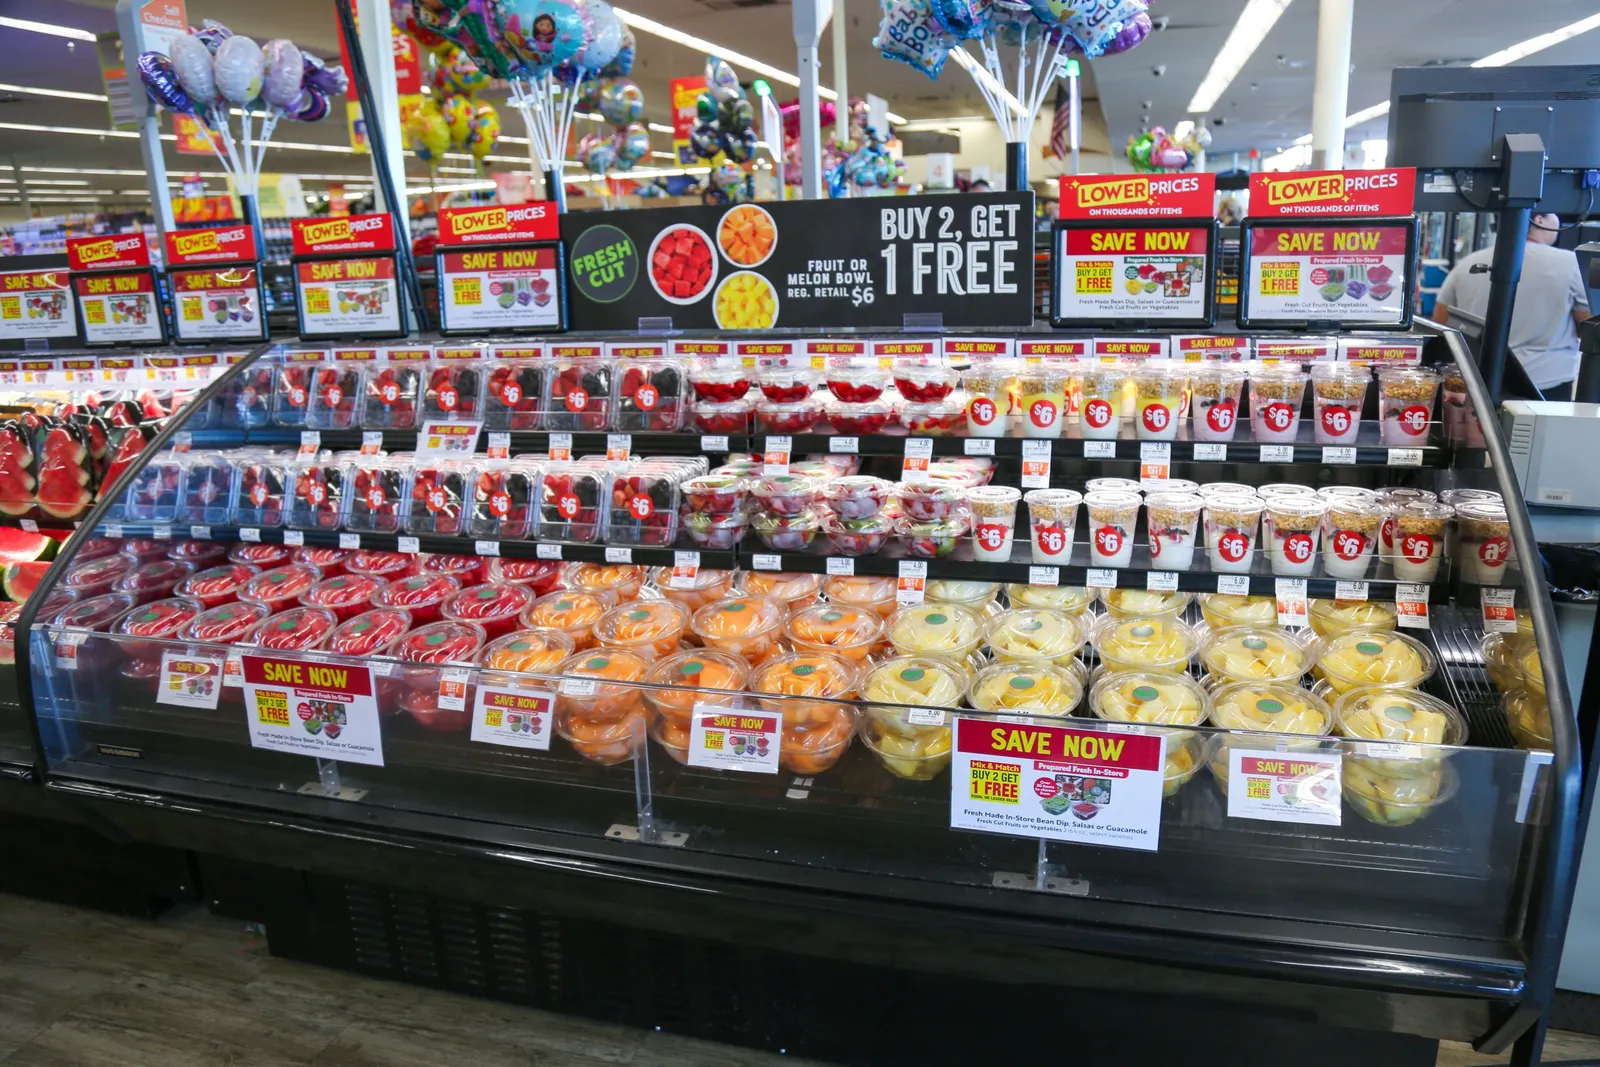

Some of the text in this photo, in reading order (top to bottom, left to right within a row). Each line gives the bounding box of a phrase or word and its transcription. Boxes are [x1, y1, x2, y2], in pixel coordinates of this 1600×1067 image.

[1081, 177, 1199, 204] LOWER PRICES
[1272, 173, 1398, 201] LOWER PRICES
[1089, 208, 1101, 216] ON
[1149, 207, 1159, 215] OF
[1160, 207, 1182, 215] ITEMS
[1280, 206, 1293, 214] ON
[1356, 204, 1379, 212] ITEMS
[455, 206, 546, 231] LOWER PRICES
[880, 204, 1021, 242] BUY 2, GET
[305, 217, 383, 241] LOWER PRICES
[178, 229, 245, 254] LOWER PRICES
[1091, 232, 1190, 251] SAVE NOW
[1277, 232, 1380, 251] SAVE NOW
[462, 250, 537, 269] SAVE NOW
[573, 240, 632, 276] FRESH
[808, 258, 868, 272] FRUIT OR
[311, 262, 377, 279] SAVE NOW
[588, 260, 625, 288] CUT
[880, 240, 1018, 296] 1 FREE
[87, 276, 139, 293] SAVE NOW
[186, 274, 212, 288] SAVE
[787, 272, 874, 285] MELON BOWL
[1077, 277, 1112, 289] 1 FREE
[1262, 278, 1298, 291] 1 FREE
[787, 286, 875, 307] REG. RETAIL $6
[837, 344, 855, 352] NOW
[1031, 345, 1073, 353] SAVE NOW
[1190, 338, 1235, 348] SAVE NOW
[1358, 349, 1405, 358] SAVE NOW
[504, 386, 518, 402] $6
[569, 392, 584, 408] $6
[638, 388, 654, 405] $6
[974, 403, 992, 421] $6
[1033, 404, 1052, 424] $6
[1146, 408, 1165, 427] $6
[1212, 409, 1231, 428] $6
[1405, 411, 1424, 430] $6
[1326, 411, 1347, 431] $6
[1100, 442, 1111, 450] 6.00
[1210, 445, 1222, 453] 6.00
[429, 491, 443, 508] $6
[633, 497, 649, 516] $6
[981, 527, 1000, 547] $6
[1338, 534, 1358, 556] $6
[1407, 537, 1428, 558] $6
[1414, 585, 1425, 593] 6.00
[263, 662, 347, 689] SAVE NOW
[495, 695, 538, 710] SAVE NOW
[259, 707, 288, 721] 1 FREE
[714, 718, 764, 730] SAVE NOW
[991, 728, 1126, 762] SAVE NOW
[995, 764, 1019, 772] Match
[1038, 762, 1124, 778] Prepared Fresh In-Store
[1257, 760, 1285, 775] SAVE
[972, 770, 1019, 783] BUY 2 GET
[972, 780, 1018, 798] 1 FREE
[964, 809, 983, 817] Fresh
[985, 811, 1004, 819] Made
[1005, 814, 1035, 823] In-Store
[1036, 817, 1055, 825] Bean
[1072, 821, 1095, 830] Salsas
[1105, 824, 1148, 835] Guacamole
[1030, 824, 1063, 833] Vegetables
